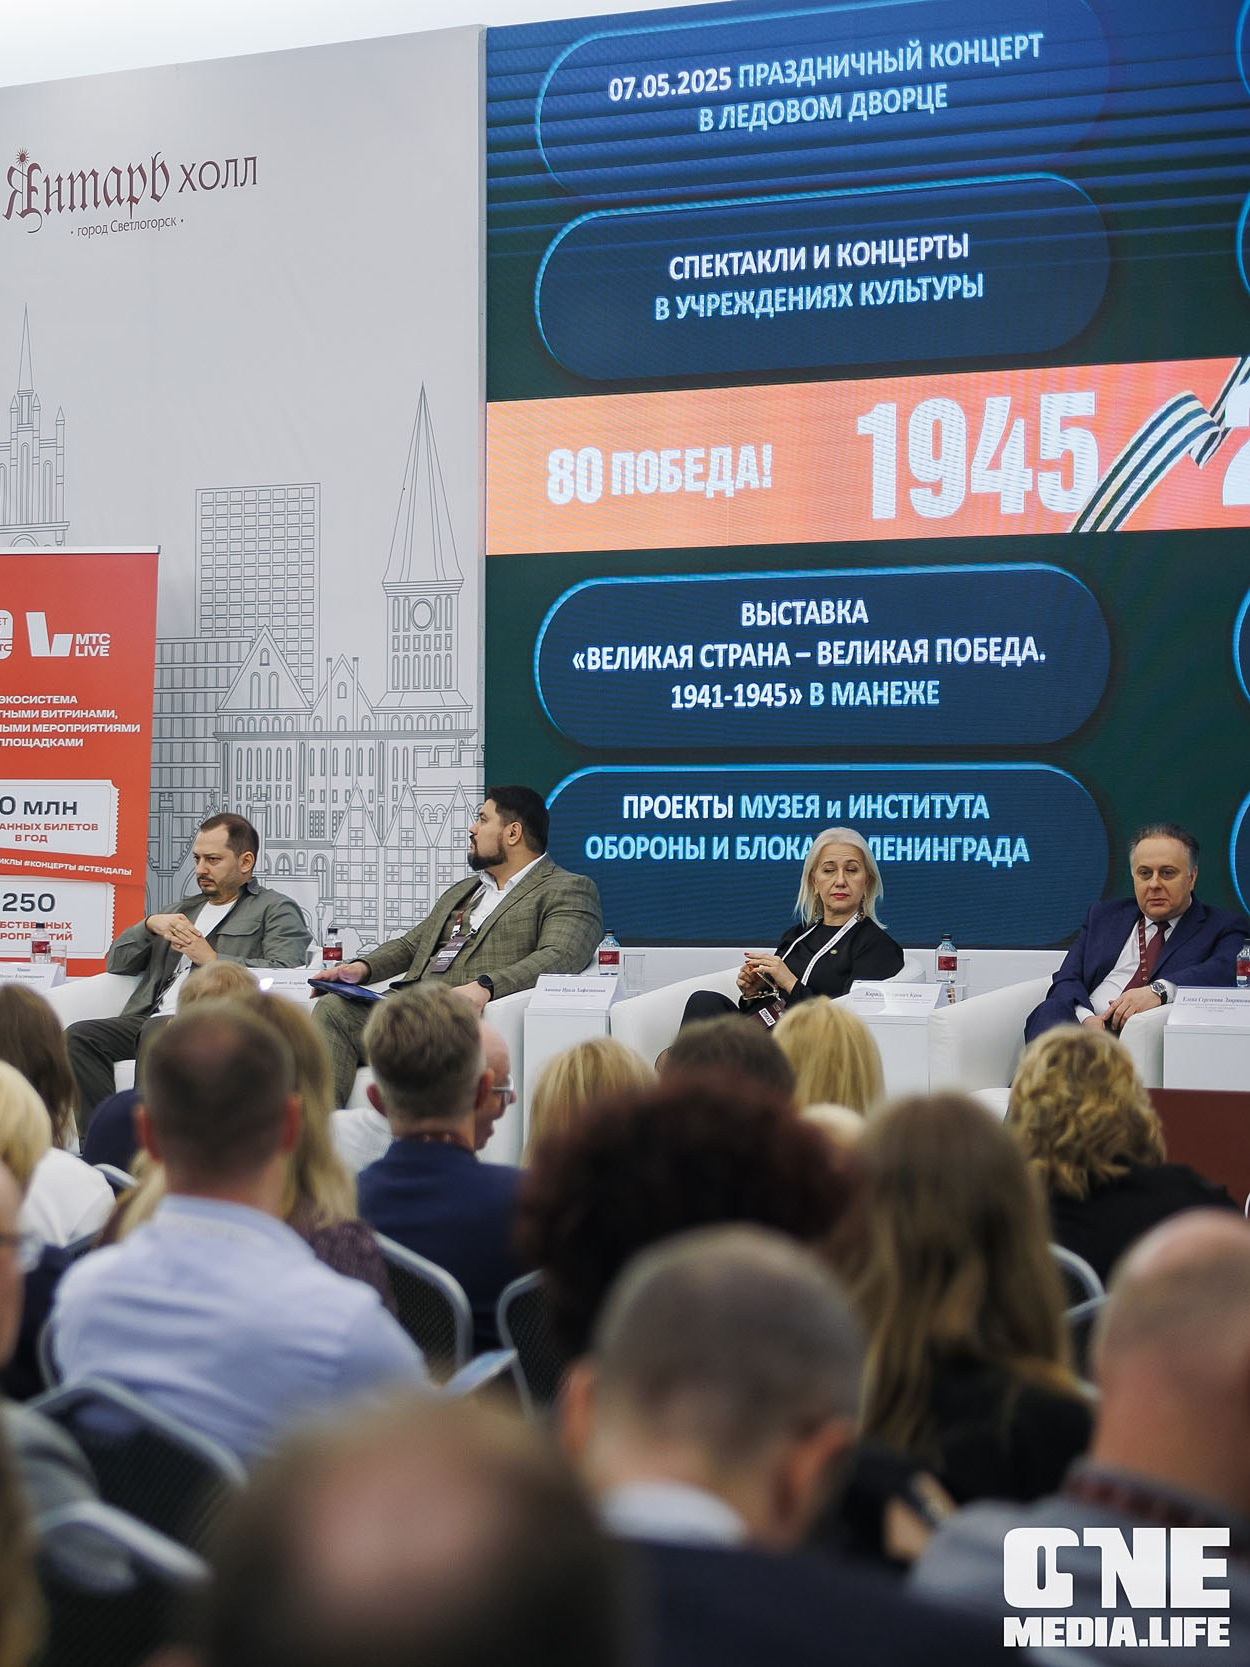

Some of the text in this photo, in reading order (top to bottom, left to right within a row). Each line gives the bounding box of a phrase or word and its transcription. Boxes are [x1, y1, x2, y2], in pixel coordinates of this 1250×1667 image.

[608, 33, 1044, 102] 07.05.2025 ПРАЗДНИЧНЫЙ КОНЦЕРТ
[700, 84, 948, 132] В ЛЕДОВОМ ДВОРЦЕ
[77, 215, 177, 237] город Светлогорск
[669, 233, 969, 280] СПЕКТАКЛИ И КОНЦЕРТЫ
[655, 273, 983, 321] В УЧРЕЖДЕНИЯХ КУЛЬТУРЫ
[858, 392, 1099, 520] 1945
[547, 445, 773, 505] 80 ПОБЕДА!
[741, 599, 868, 627] ВЫСТАВКА
[76, 646, 110, 656] LIVE
[573, 645, 694, 672] «ВЕЛИКАЯ
[700, 642, 790, 669] СТРАНА
[818, 639, 929, 666] ВЕЛИКАЯ
[935, 637, 1046, 667] ПОБЕДА.
[671, 681, 940, 709] 1941-1945» В МАНЕЖЕ
[41, 710, 118, 720] ВИТРИНАМИ,
[33, 724, 140, 733] МЕРОПРИЯТИЯМИ
[622, 795, 734, 820] ПРОЕКТЫ
[740, 795, 820, 820] МУЗЕЯ
[849, 794, 989, 819] ИНСТИТУТА
[24, 834, 48, 843] ГОД
[44, 823, 99, 831] БИЛЕТОВ
[586, 836, 705, 861] ОБОРОНЫ
[711, 836, 729, 860] И
[24, 860, 76, 870] #КОНЦЕРТЫ
[78, 865, 132, 875] #СТЕНДАПЫ
[3, 893, 56, 912] 250
